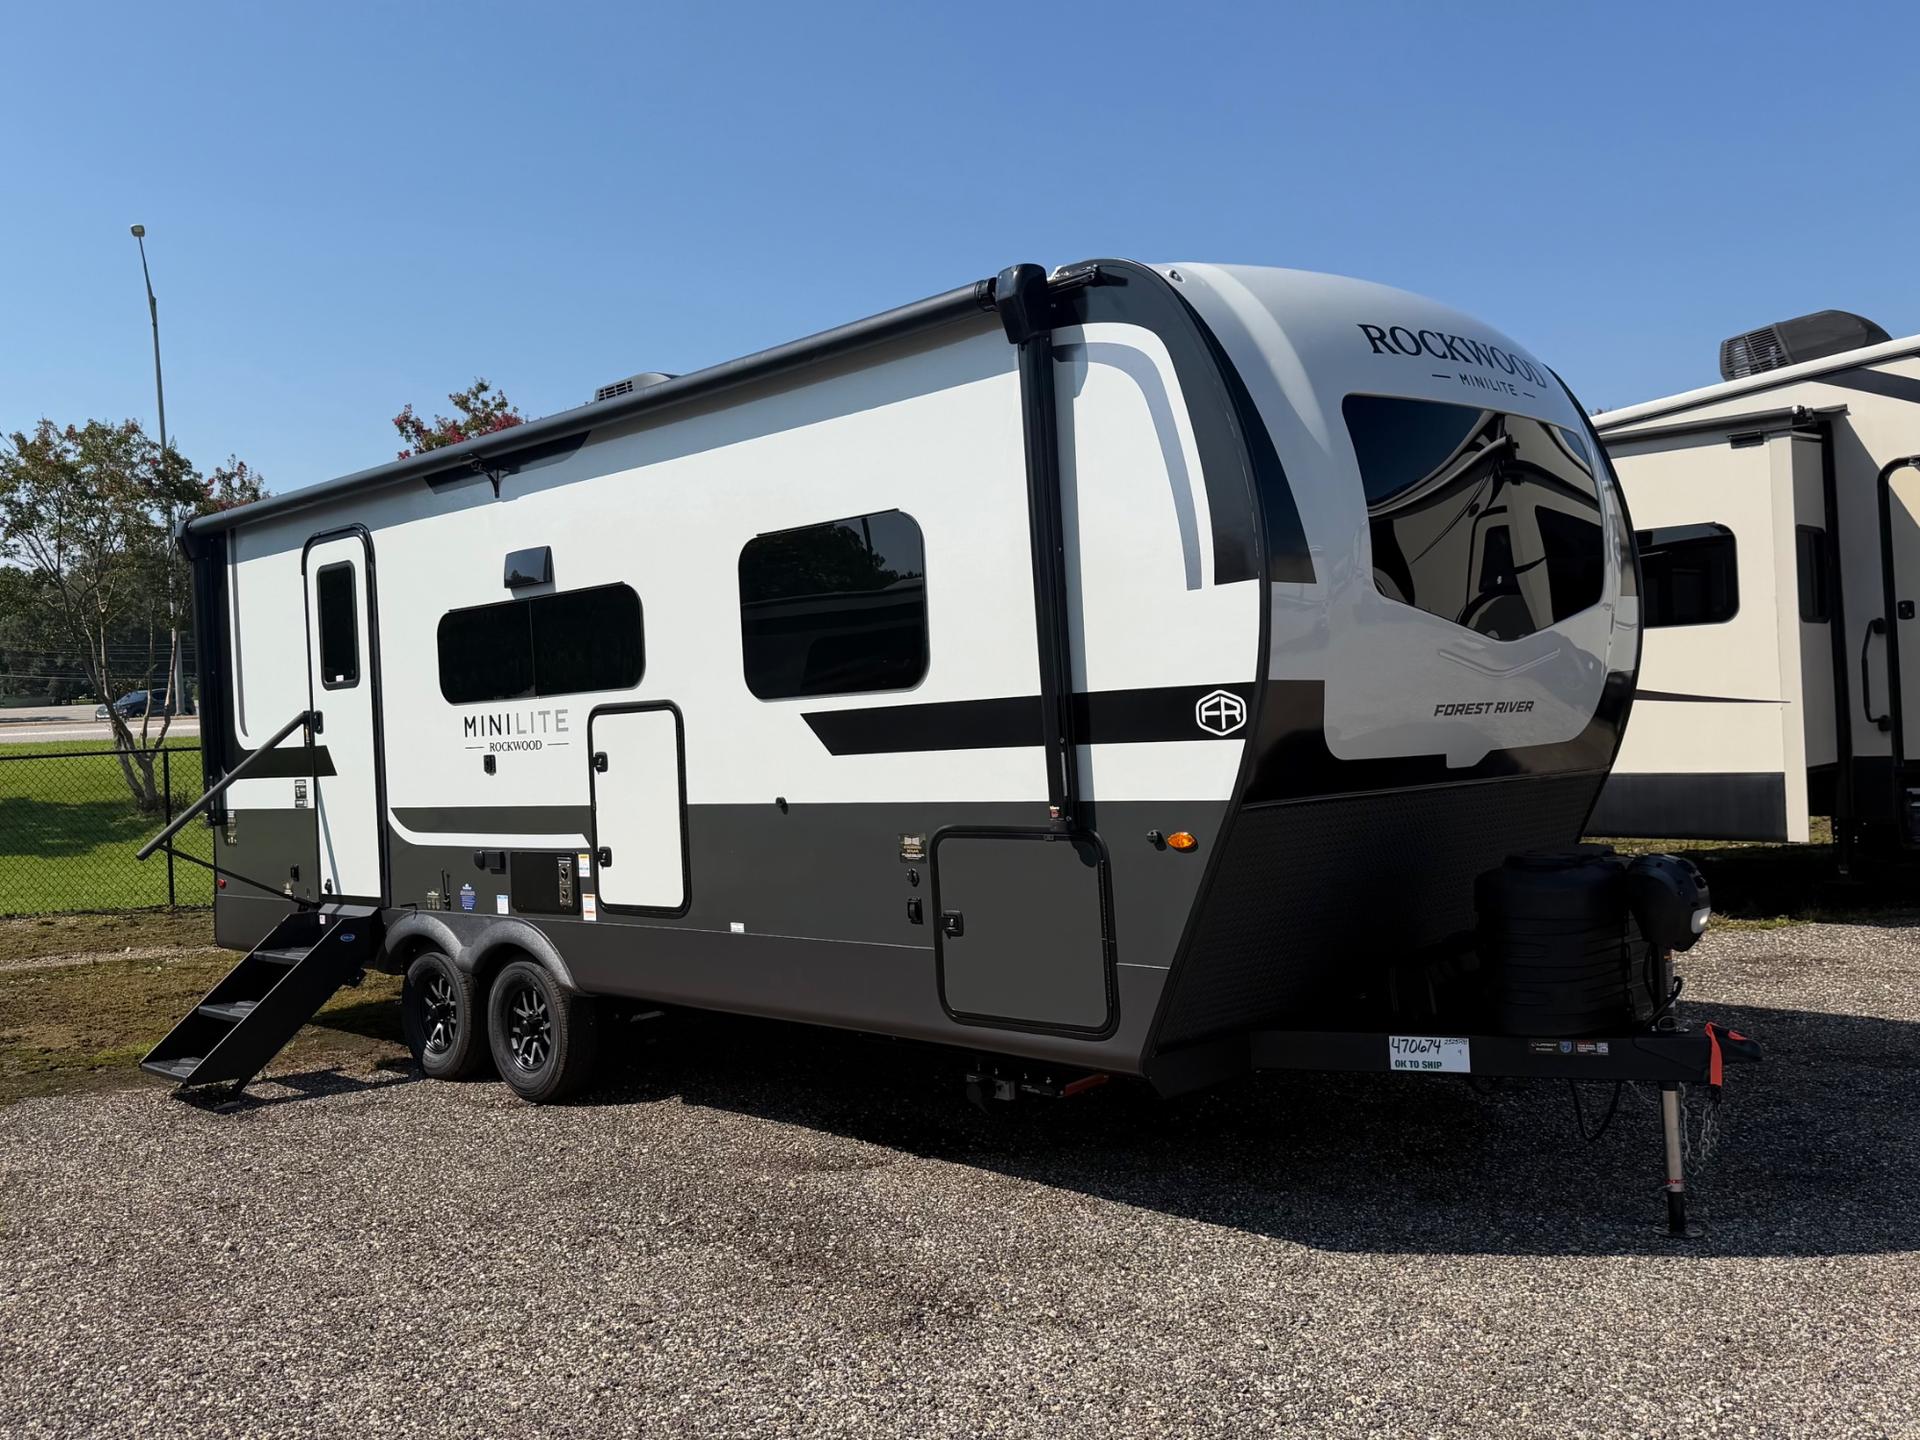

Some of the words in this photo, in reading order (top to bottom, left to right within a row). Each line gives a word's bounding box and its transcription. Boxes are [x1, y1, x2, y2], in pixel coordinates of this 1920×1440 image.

[1357, 323, 1548, 389] ROCKWOOD
[1459, 372, 1518, 397] MINILITE
[1433, 702, 1494, 717] FOREST
[1494, 700, 1535, 714] RIVER
[464, 709, 569, 738] MINILITE
[489, 740, 543, 752] ROCKWOOD
[1391, 1037, 1441, 1054] 470674
[1395, 1059, 1408, 1068] OK
[1408, 1060, 1419, 1069] TO
[1422, 1061, 1442, 1069] SHIP
